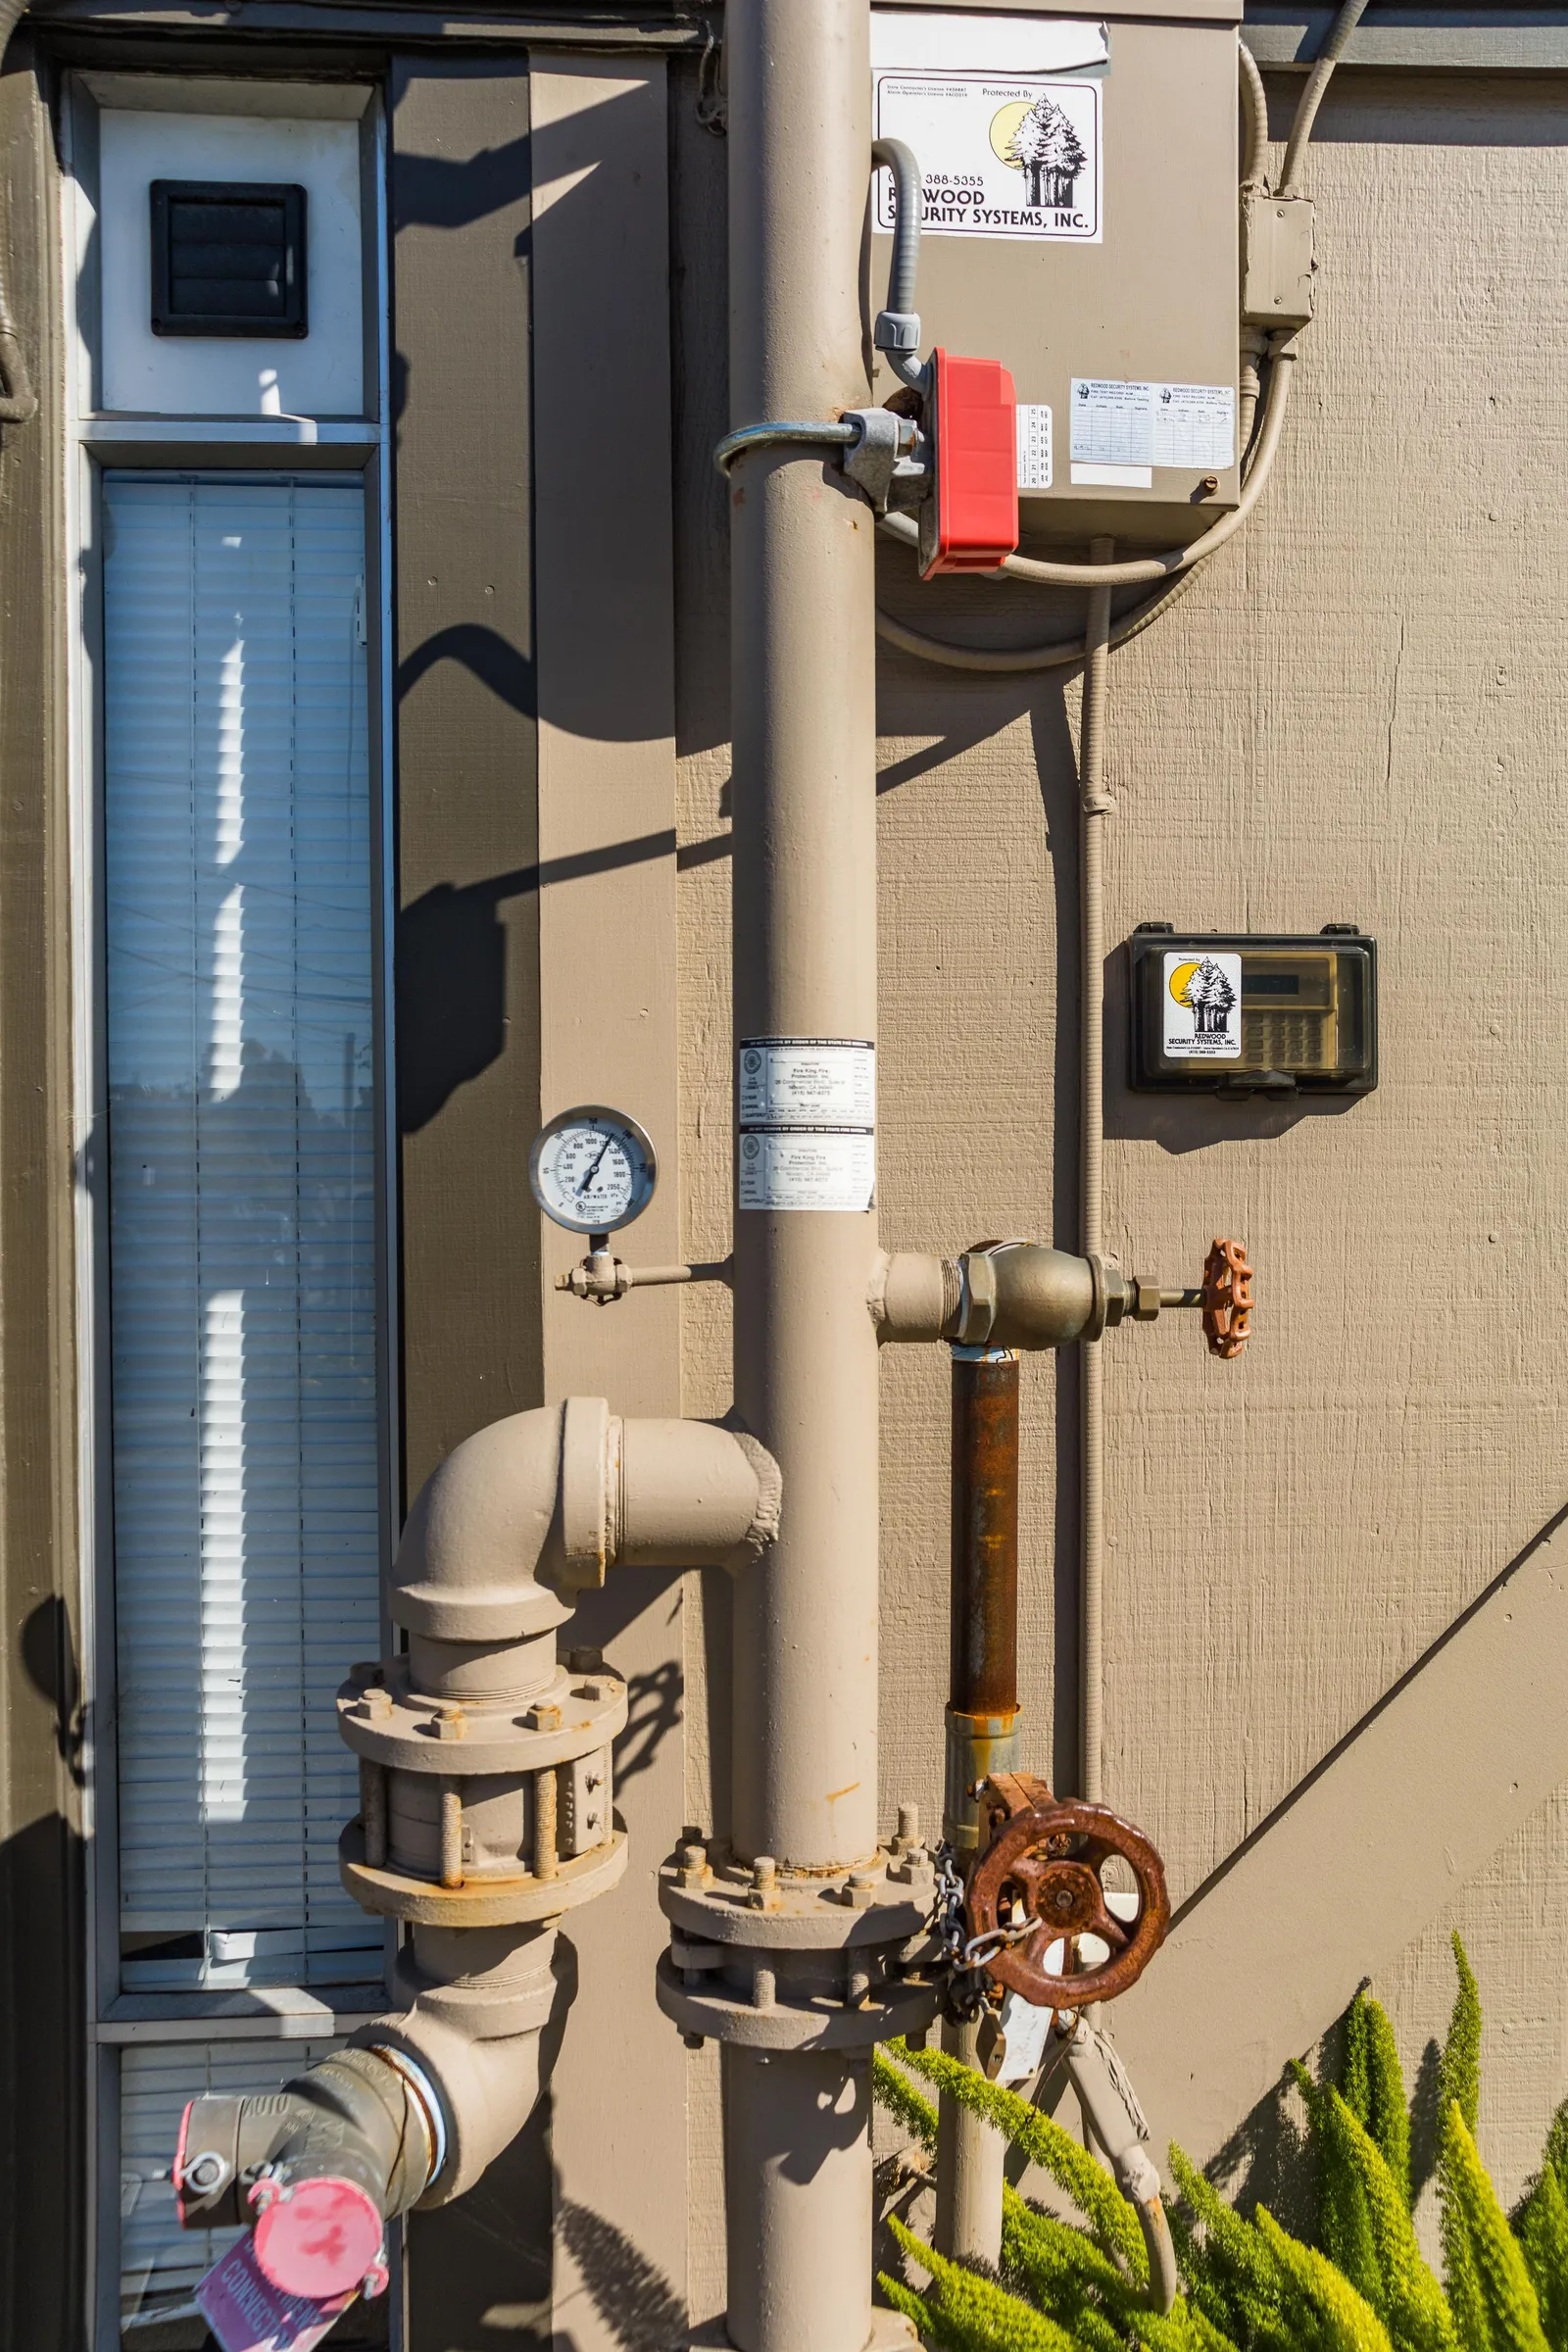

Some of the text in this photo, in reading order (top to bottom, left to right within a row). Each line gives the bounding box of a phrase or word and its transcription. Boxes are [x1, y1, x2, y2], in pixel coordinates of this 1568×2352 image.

[982, 87, 1033, 99] Protected By
[925, 173, 984, 187] 388-5355
[888, 186, 985, 206] RWOOD
[888, 204, 1089, 228] SURITY SYSTEMS, INC.
[220, 2257, 292, 2351] CONNECTI
